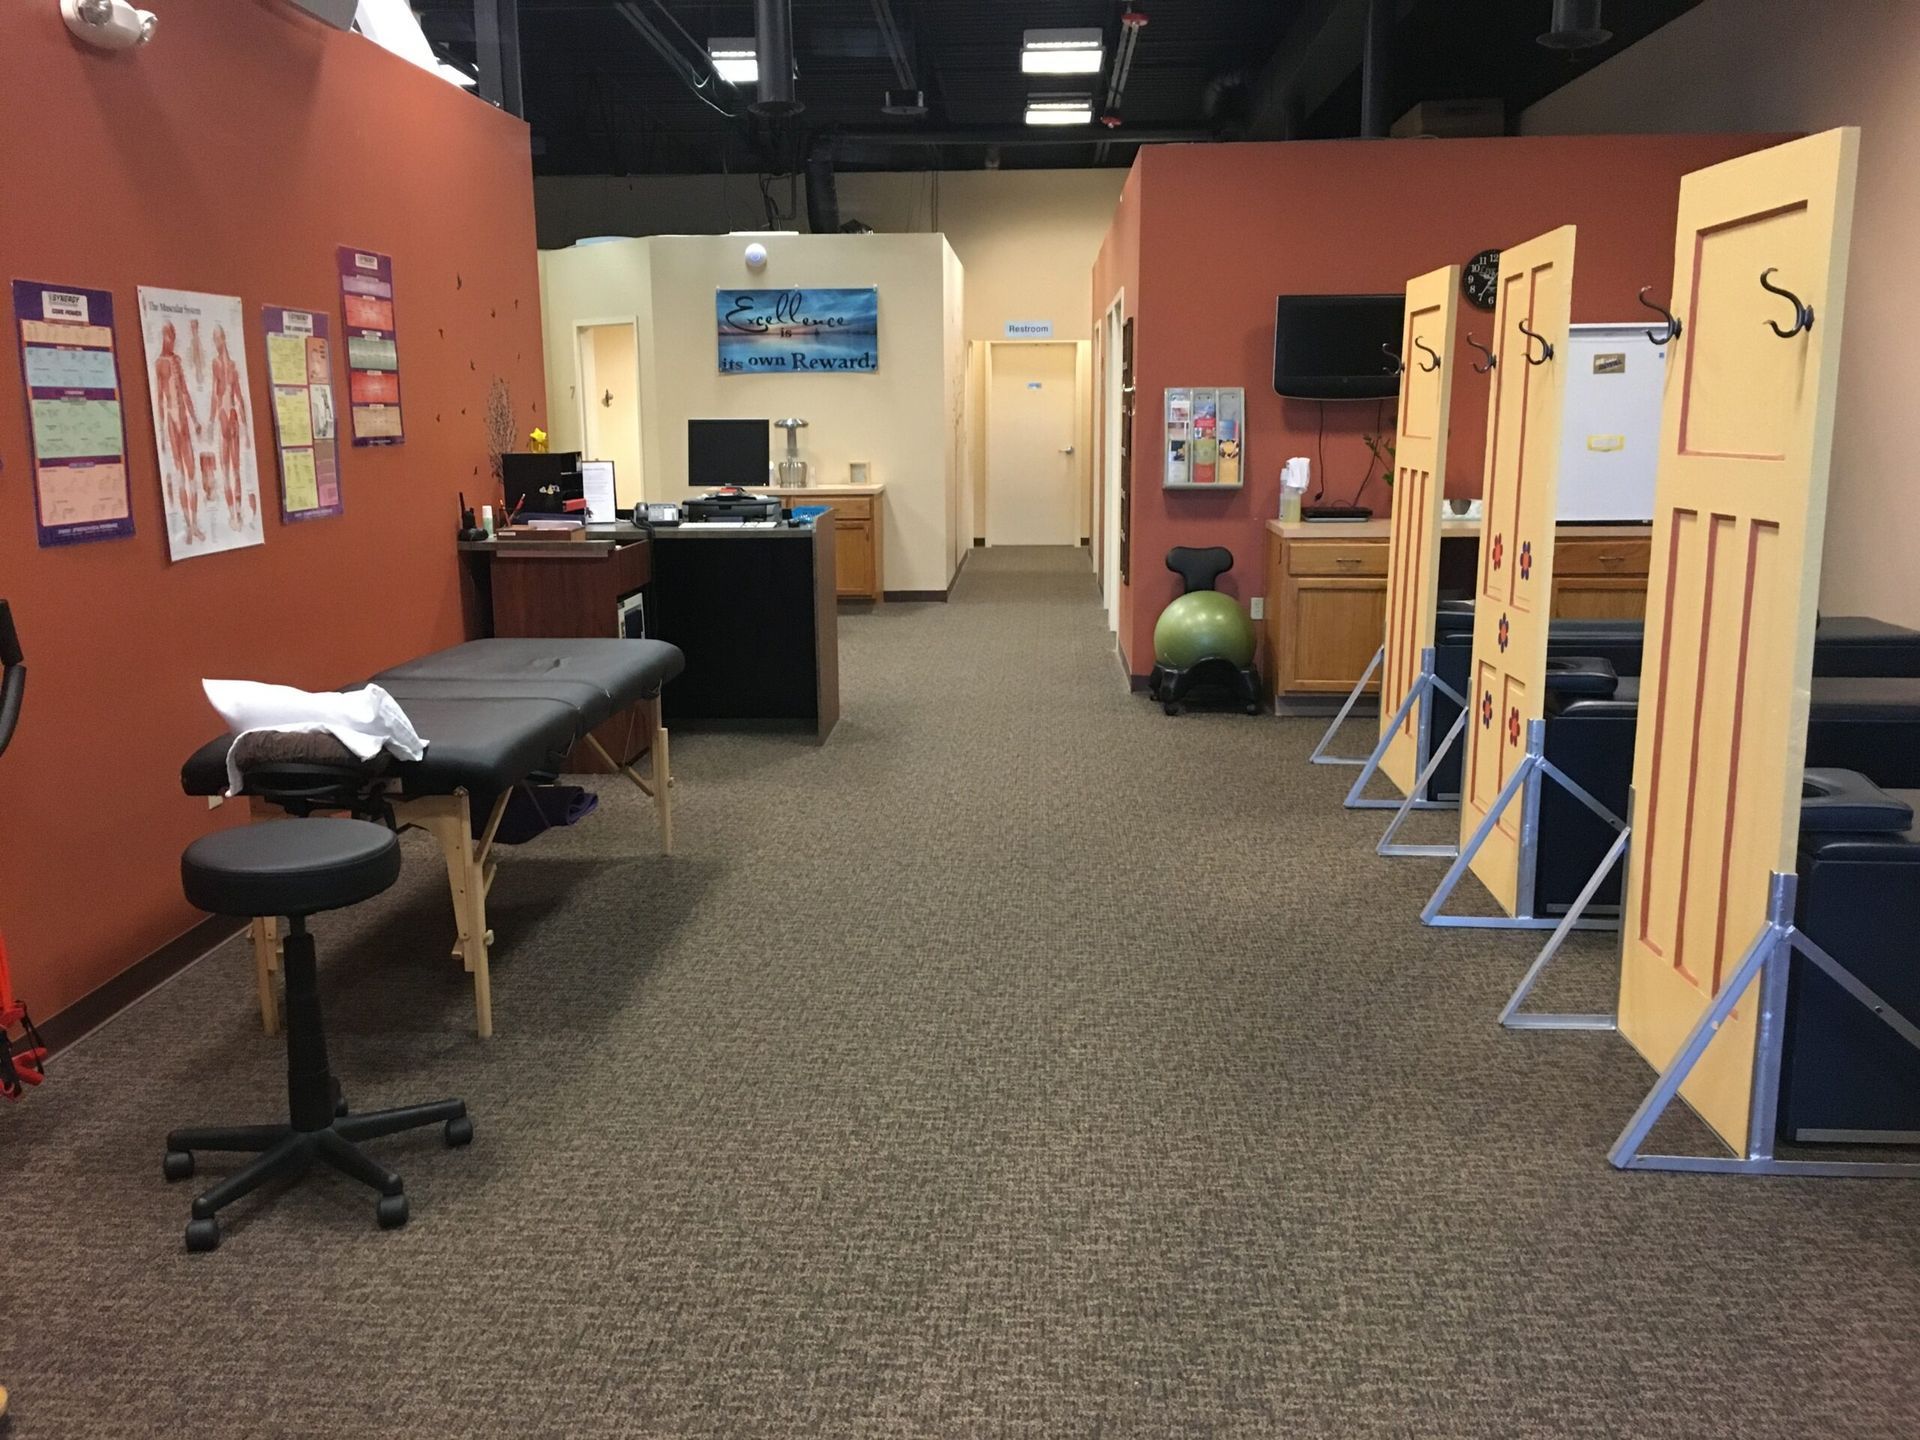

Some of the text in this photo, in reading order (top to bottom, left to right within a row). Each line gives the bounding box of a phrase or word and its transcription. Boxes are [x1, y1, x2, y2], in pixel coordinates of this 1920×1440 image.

[1479, 256, 1487, 265] 11
[1489, 254, 1499, 263] 12
[1471, 264, 1480, 273] 10
[1467, 275, 1474, 284] 9
[1469, 285, 1476, 293] 8
[1488, 296, 1494, 304] 6
[725, 292, 850, 333] Excellence
[780, 327, 792, 338] is
[1008, 324, 1049, 333] Restroom
[722, 352, 876, 371] its own Reward.
